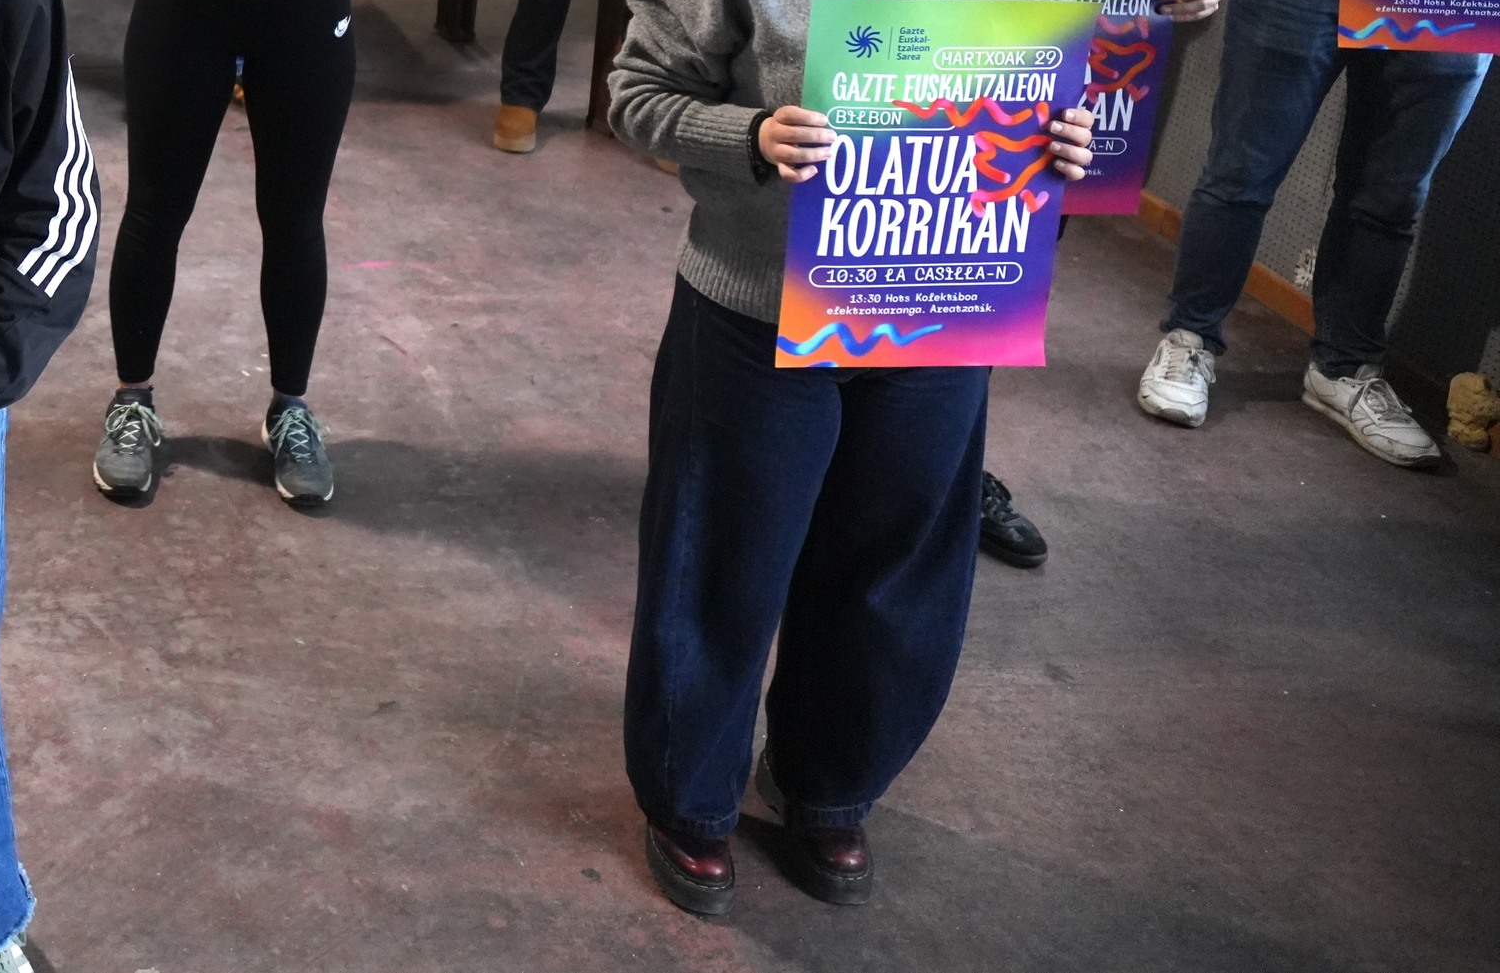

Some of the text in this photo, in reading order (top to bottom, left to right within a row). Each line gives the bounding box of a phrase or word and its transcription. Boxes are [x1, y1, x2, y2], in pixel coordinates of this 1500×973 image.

[899, 27, 925, 35] Gazte
[898, 35, 930, 43] Euskal-
[897, 44, 930, 52] tzaleon
[896, 52, 921, 60] Sarea
[940, 50, 1057, 66] MARTXOAK 29
[833, 72, 1057, 102] GAZTE EUSKALTZALEON
[835, 110, 902, 125] BILBON
[825, 134, 979, 195] OLATUA
[817, 196, 1032, 257] KORRIKAN
[826, 268, 877, 283] 10:30
[885, 267, 906, 282] LA
[849, 292, 978, 304] 13:30 Hots Kolektiboa
